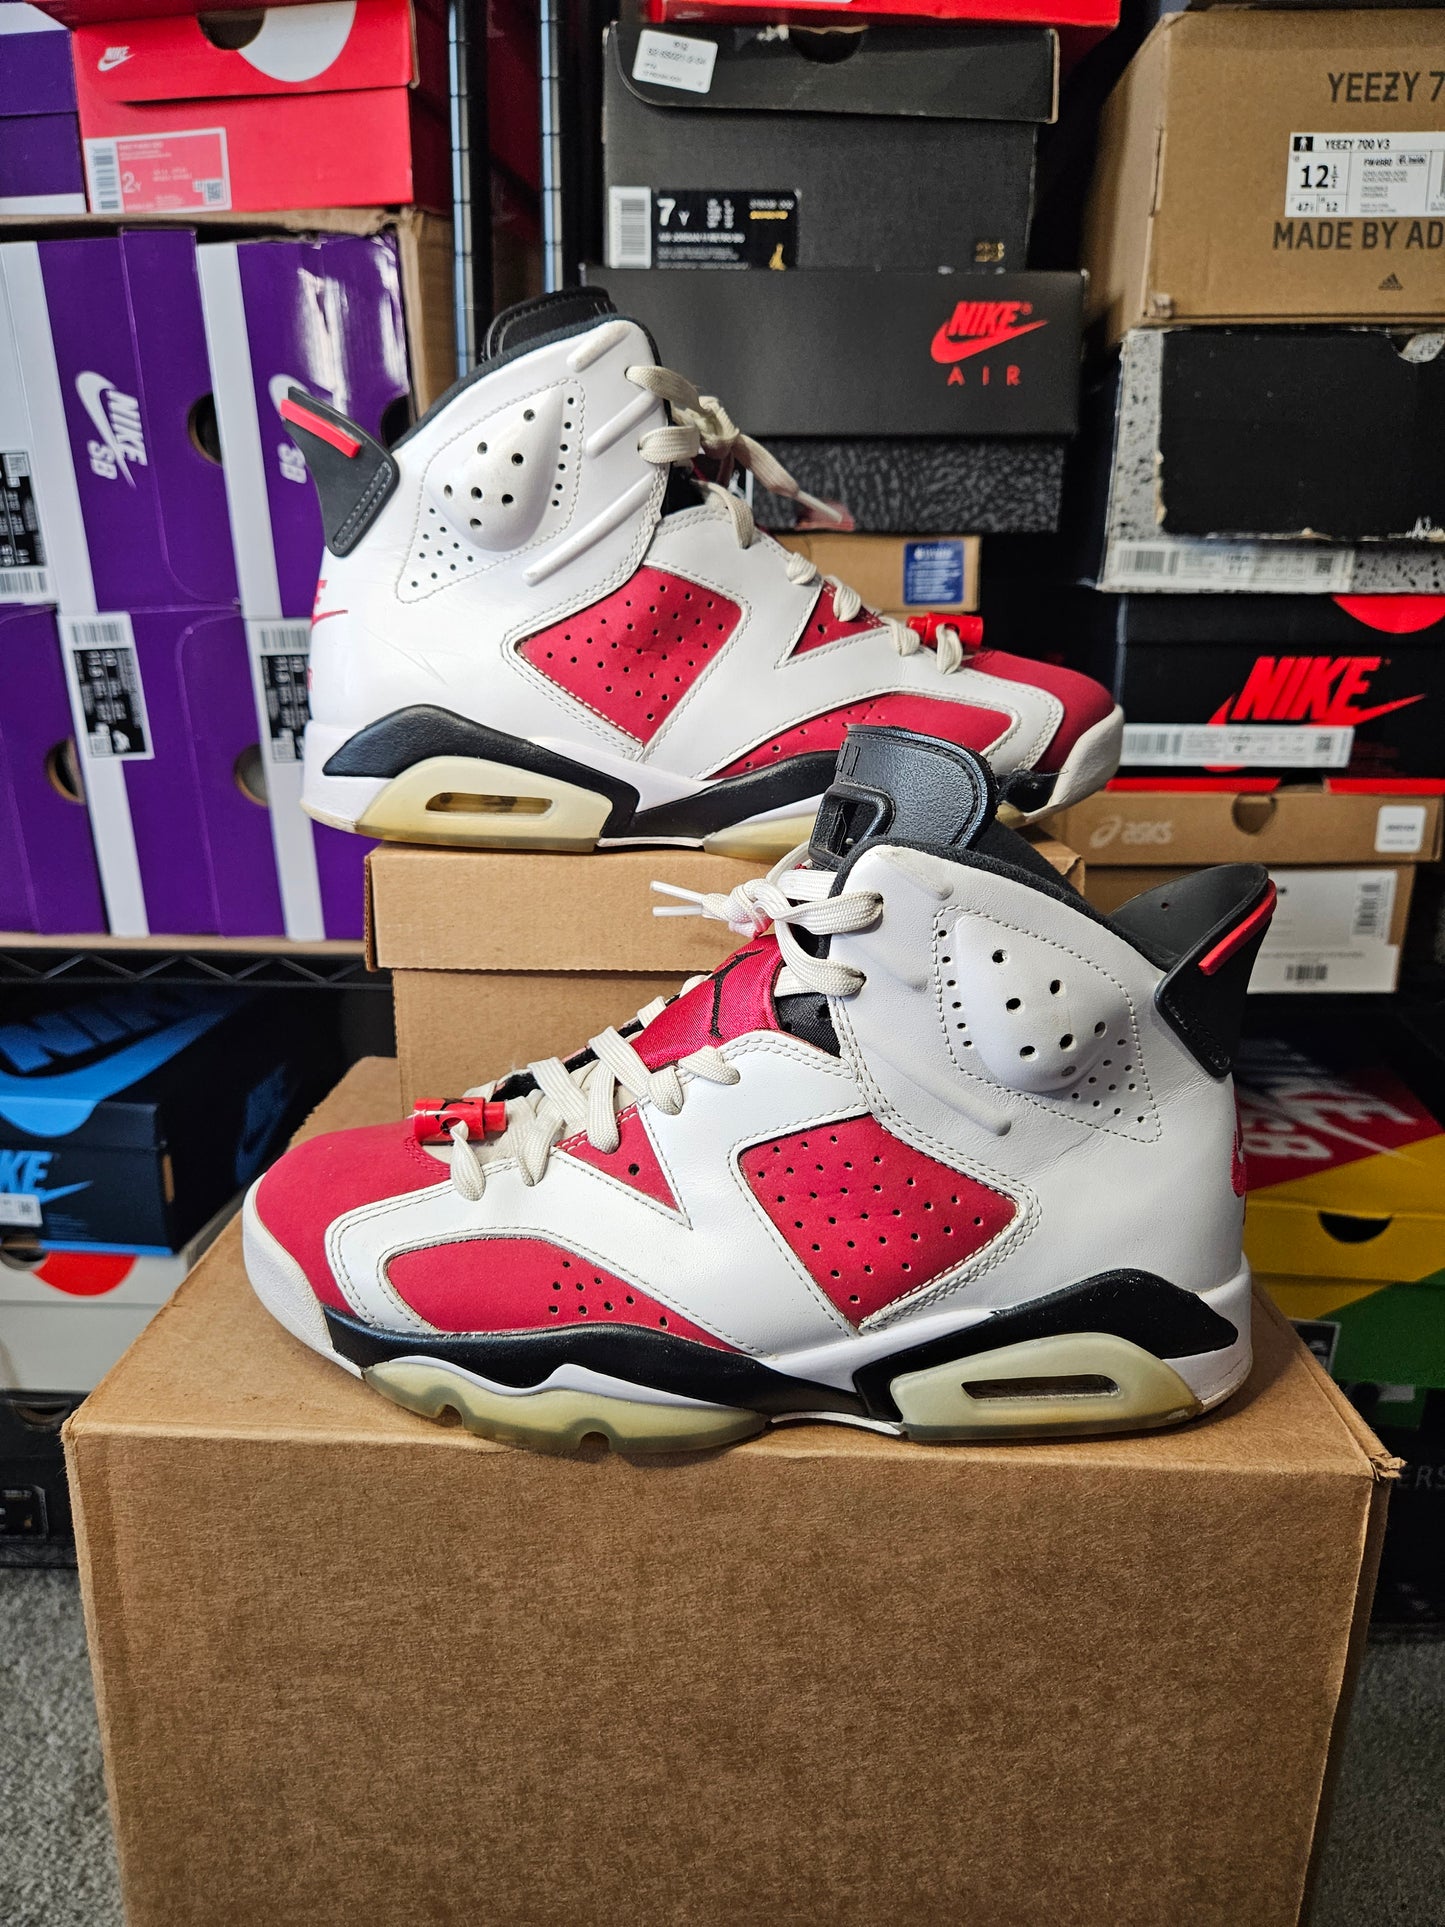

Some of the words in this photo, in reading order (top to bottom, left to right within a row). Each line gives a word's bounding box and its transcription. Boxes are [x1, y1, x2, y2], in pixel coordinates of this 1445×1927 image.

[105, 46, 130, 60] NIKE
[1328, 73, 1420, 103] YEEZY
[1325, 139, 1353, 150] YEEZY
[1357, 139, 1375, 150] 700
[1377, 139, 1390, 150] V3
[1273, 222, 1353, 250] MADE
[1362, 221, 1398, 250] BY
[946, 301, 1021, 336] NIKE
[947, 365, 1021, 386] AIR
[106, 389, 148, 466] NIKE
[87, 440, 117, 479] SB
[1230, 656, 1382, 720] NIKE
